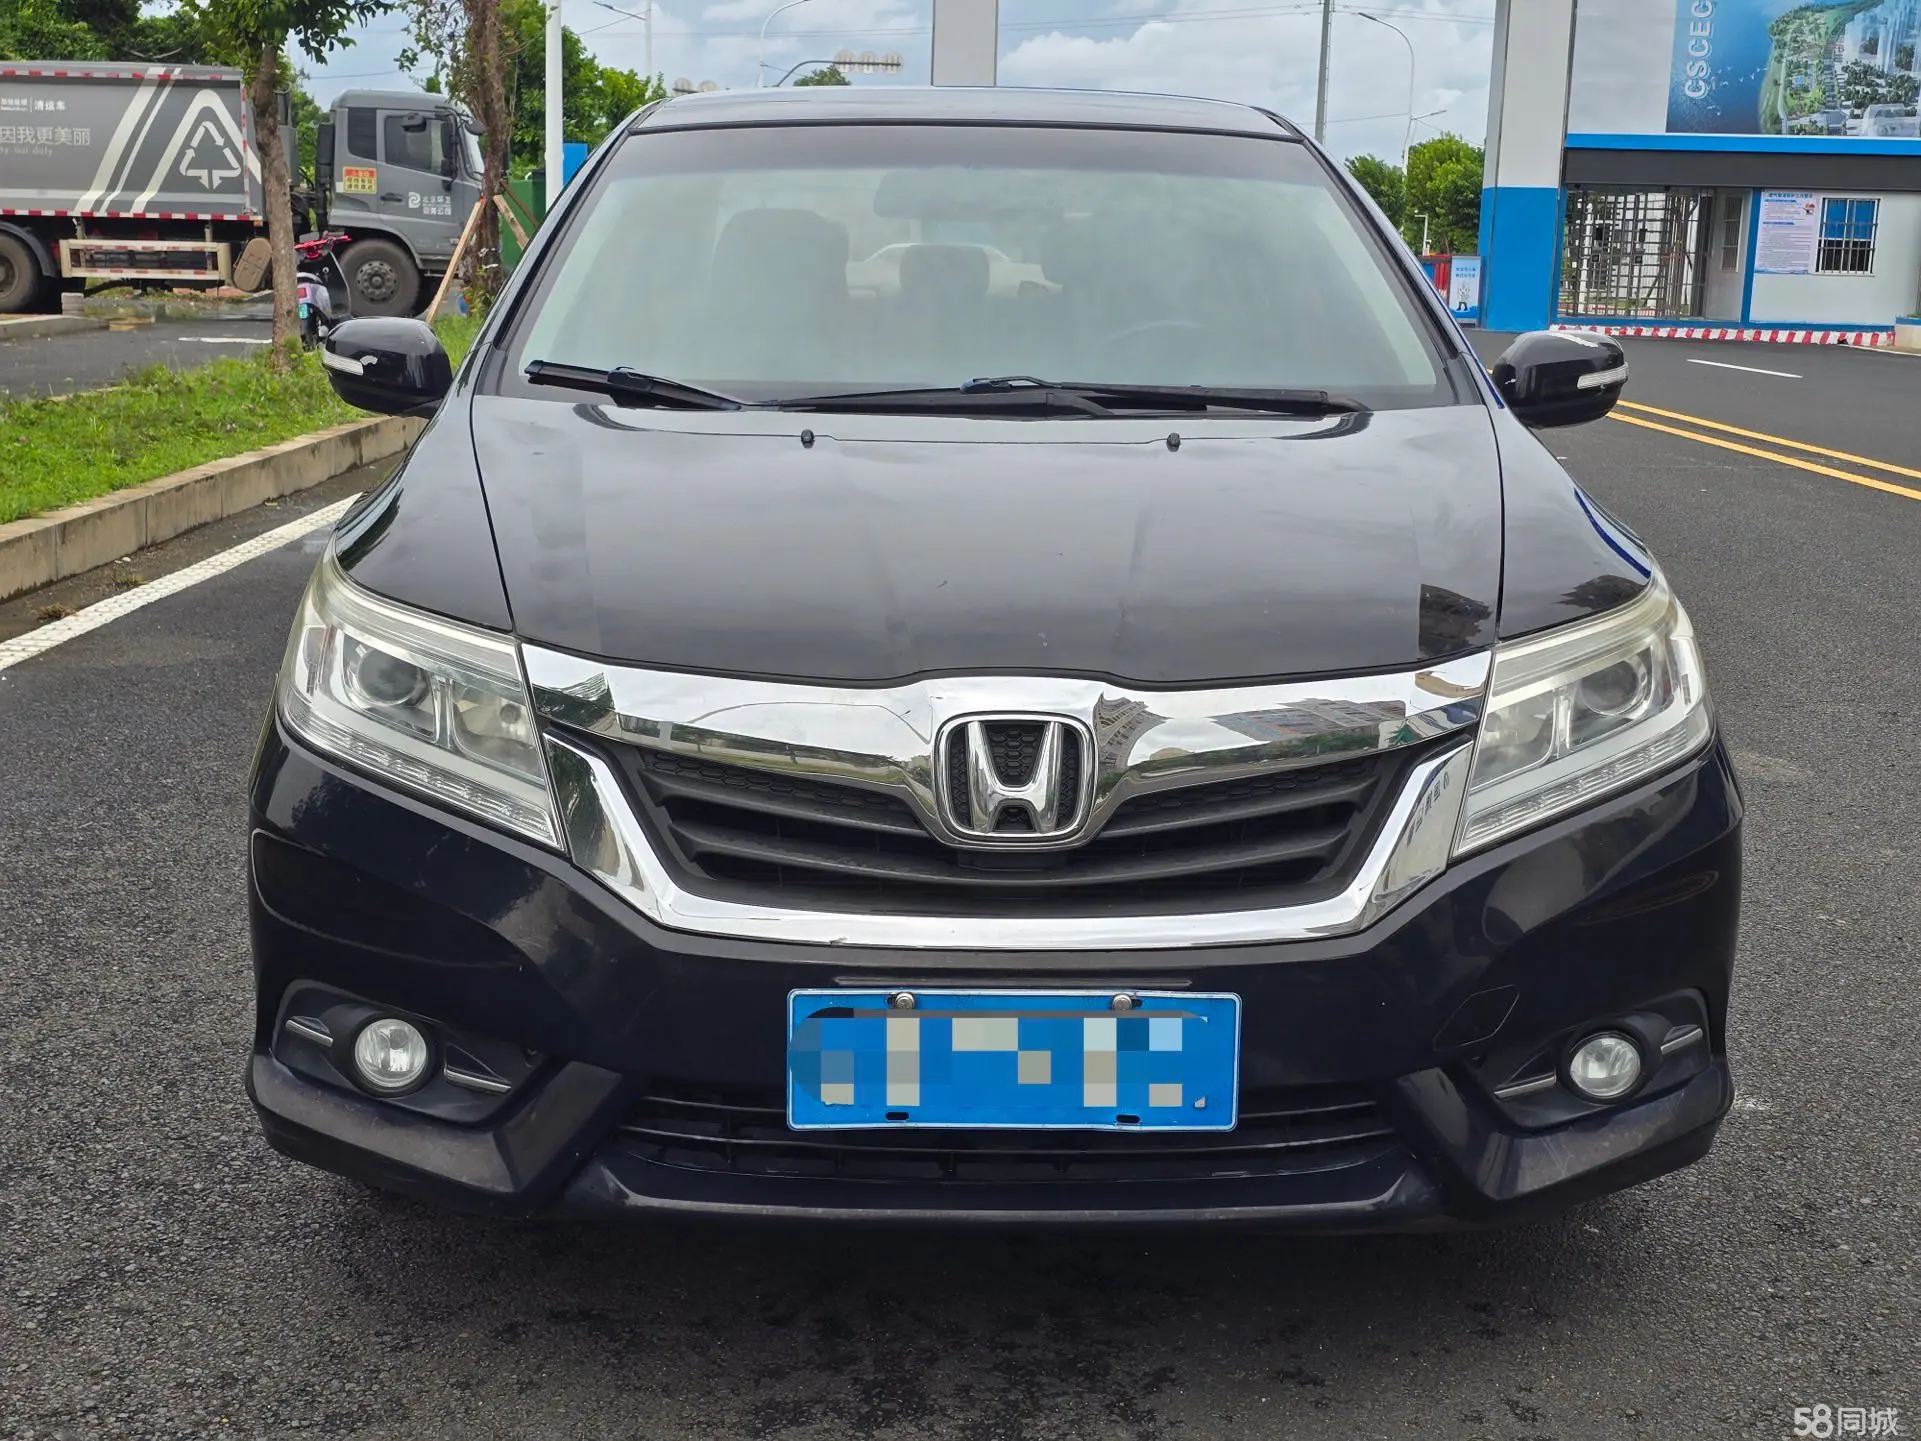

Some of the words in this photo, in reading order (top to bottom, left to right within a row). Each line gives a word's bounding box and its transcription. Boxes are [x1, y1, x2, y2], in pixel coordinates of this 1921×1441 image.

[1684, 0, 1713, 99] CSCEC
[0, 125, 91, 146] 因我更美丽
